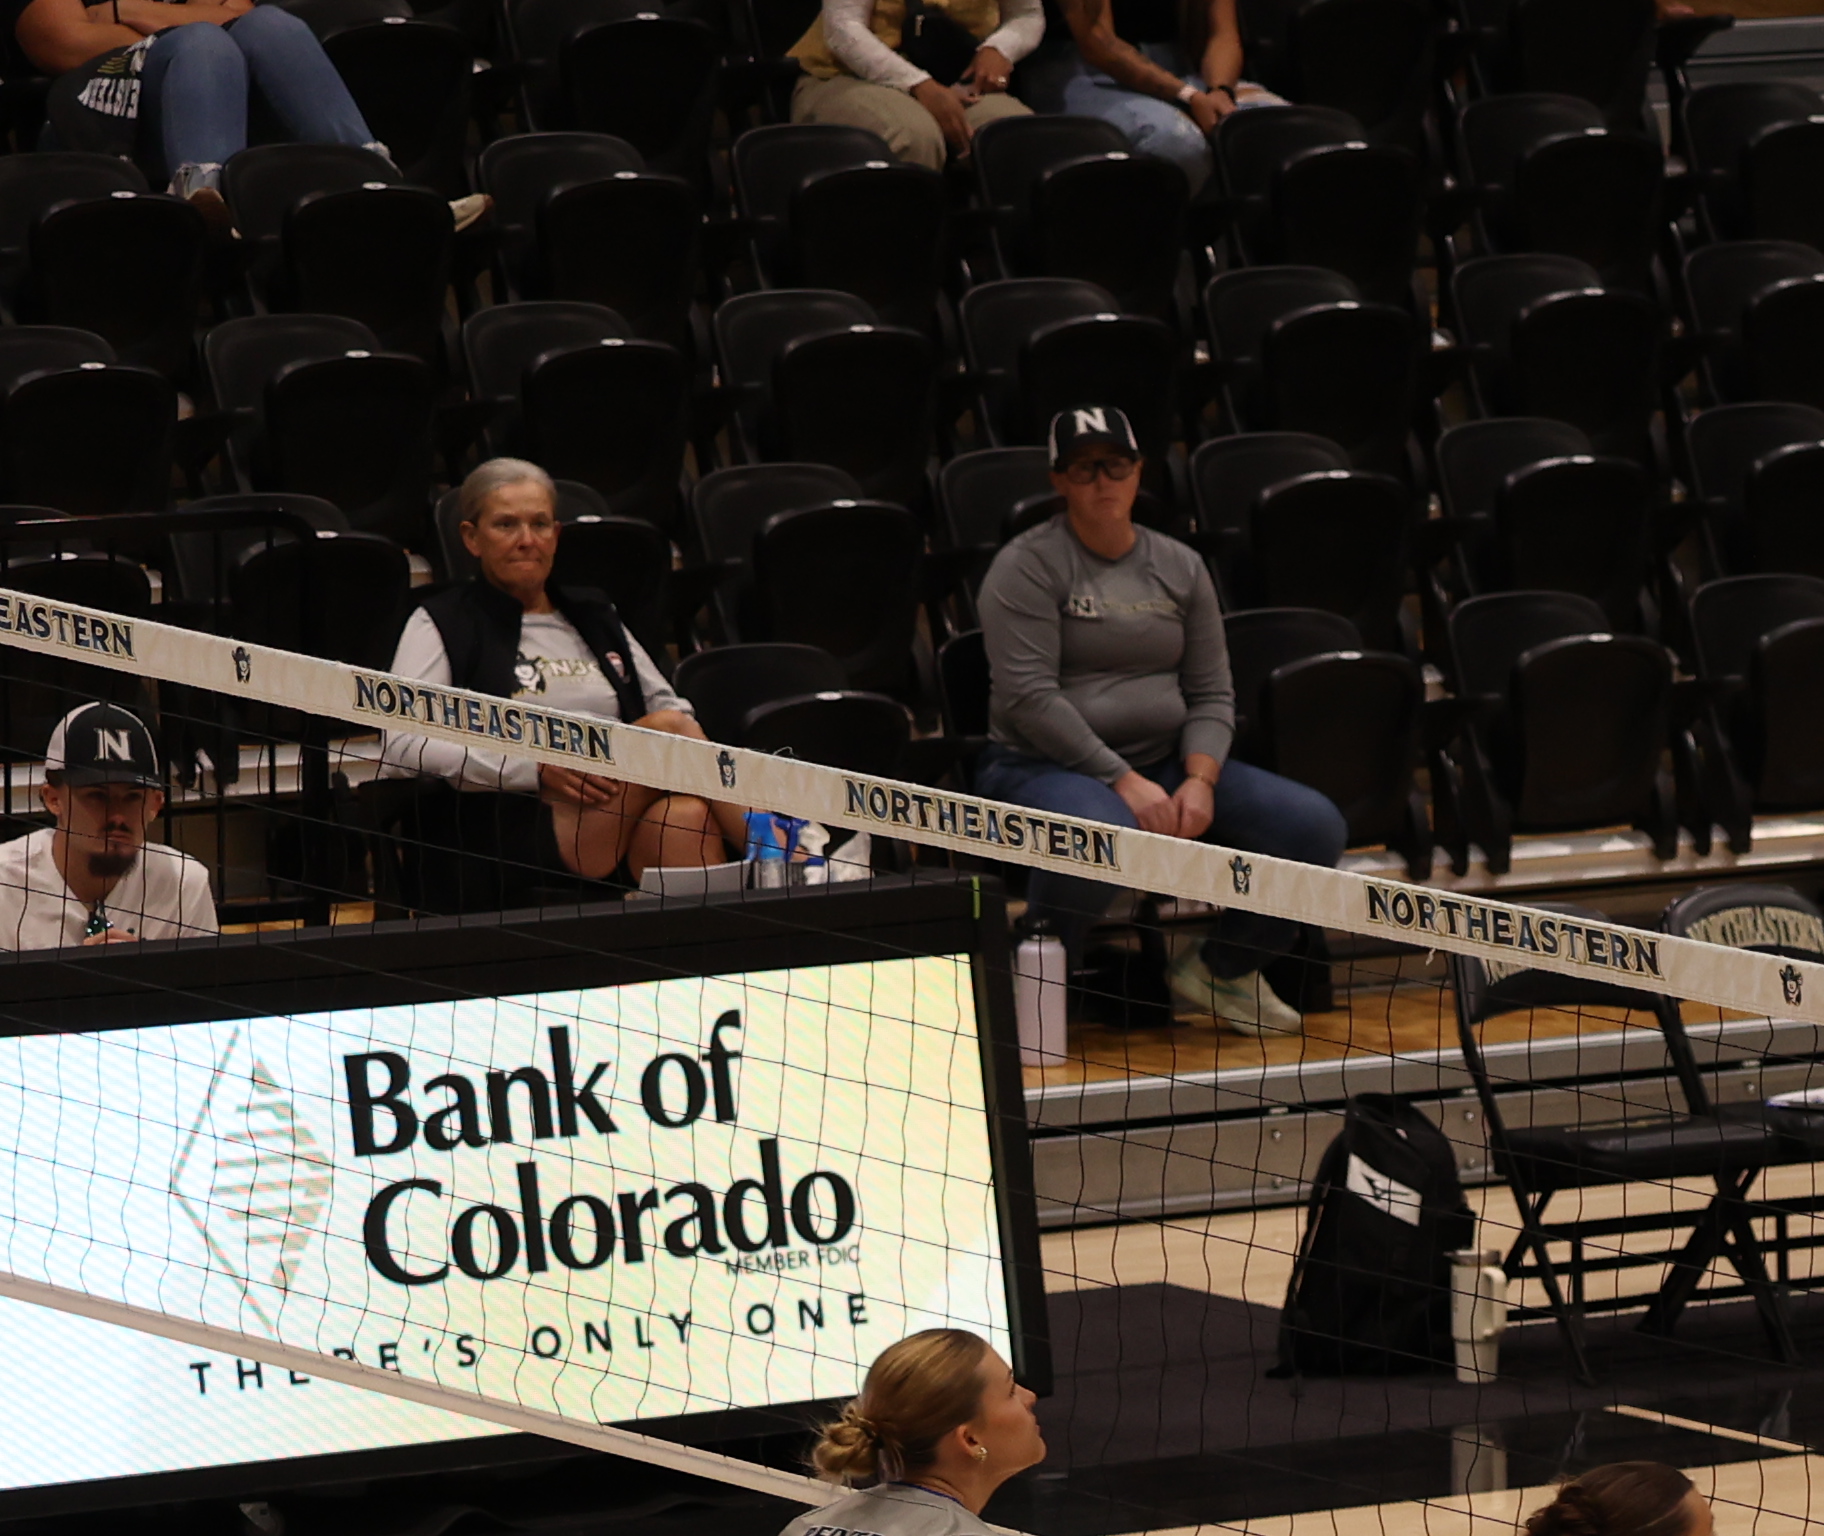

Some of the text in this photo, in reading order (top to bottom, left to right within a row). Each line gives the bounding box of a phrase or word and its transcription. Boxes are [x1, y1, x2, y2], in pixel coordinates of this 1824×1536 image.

[1075, 407, 1108, 434] N
[95, 727, 133, 762] N
[353, 674, 614, 764] NORTHEASTERN
[842, 777, 1121, 872] NORTHEASTERN
[1364, 882, 1665, 980] NORTHEASTERN
[343, 1009, 743, 1158] Bank of
[362, 1138, 857, 1286] Colorado
[724, 1251, 810, 1275] MEMBER
[533, 1311, 693, 1359] ONLY
[747, 1292, 869, 1336] ONE
